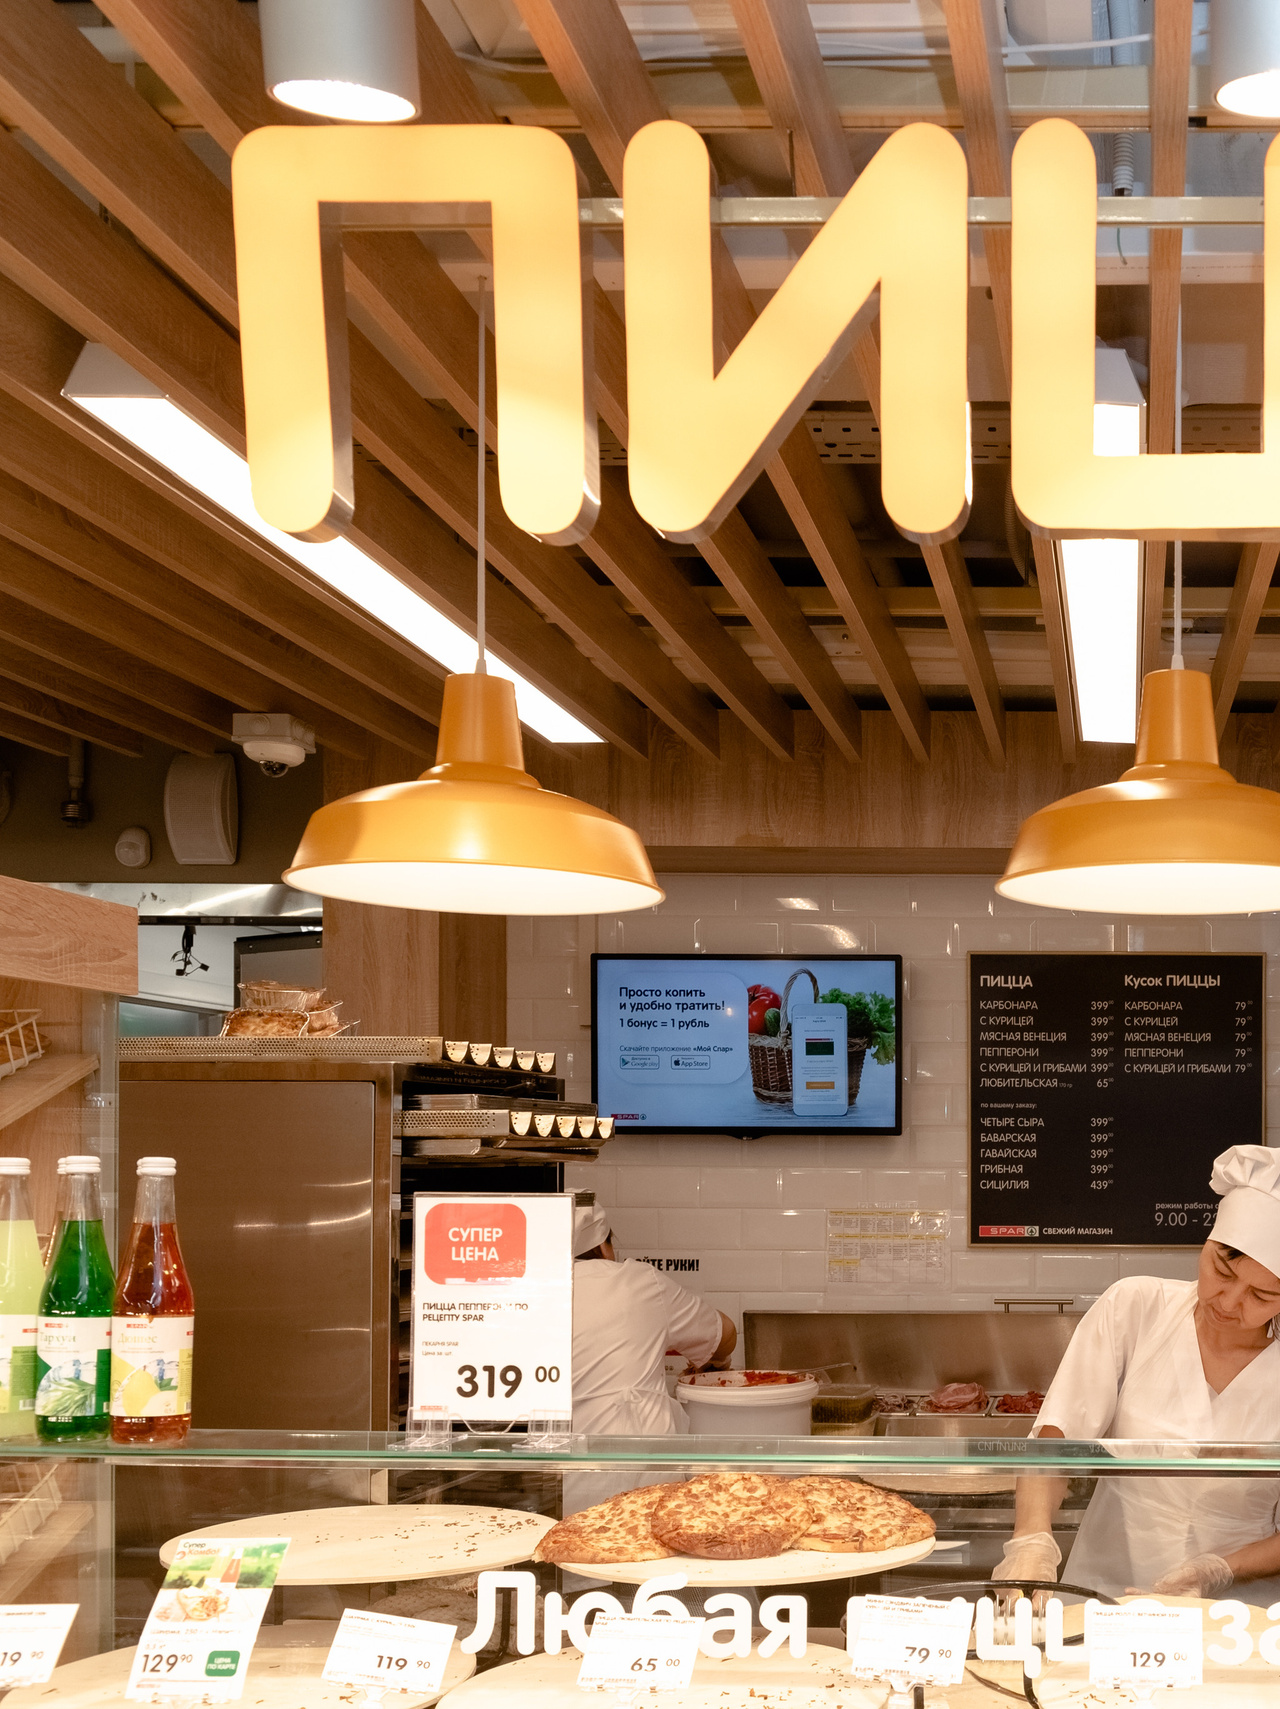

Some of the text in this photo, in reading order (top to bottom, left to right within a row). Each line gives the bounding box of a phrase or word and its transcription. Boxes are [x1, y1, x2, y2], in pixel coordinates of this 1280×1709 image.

[980, 975, 1033, 989] ПИЦЦА
[1125, 975, 1220, 989] Кусок ПИЦЦЫ
[619, 987, 705, 999] Просто копить
[619, 1001, 725, 1012] и удобно тратить!
[980, 1001, 1038, 1009] КАРБОНАРА
[1125, 1001, 1182, 1010] КАРБОНАРА
[620, 1018, 709, 1029] 1 бонус 1 рубль
[980, 1016, 1033, 1027] С КУРИЦЕЙ
[1125, 1017, 1178, 1027] С КУРИЦЕЙ
[980, 1032, 1066, 1043] МЯСНАЯ ВЕНЕЦИЯ
[1125, 1033, 1211, 1043] МЯСНАЯ ВЕНЕЦИЯ
[618, 1044, 650, 1053] Скачайте
[650, 1046, 692, 1054] приложение
[712, 1045, 734, 1054] Спар»
[980, 1047, 1038, 1056] ПЕППЕРОНИ
[1125, 1048, 1183, 1057] ПЕППЕРОНИ
[680, 1060, 694, 1068] App
[980, 1063, 1086, 1074] С КУРИЦЕЙ И ГРИБАМИ
[1125, 1063, 1231, 1074] С КУРИЦЕЙ И ГРИБАМИ
[980, 1078, 1057, 1087] ЛЮБИТЕЛЬСКАЯ
[988, 1102, 1015, 1110] вашему
[1015, 1102, 1038, 1110] заказу:
[981, 1118, 1044, 1126] ЧЕТЫРЕ СЫРА
[981, 1133, 1036, 1142] БАВАРСКАЯ
[981, 1148, 1036, 1158] ГАВАЙСКАЯ
[981, 1165, 1023, 1173] ГРИБНАЯ
[980, 1180, 1029, 1191] СИЦИЛИЯ
[1155, 1202, 1213, 1211] режим работы
[1155, 1212, 1187, 1226] 9.00
[449, 1227, 502, 1242] СУПЕР
[989, 1227, 1025, 1235] SPAR
[1043, 1226, 1114, 1236] СВЕЖИЙ МАГАЗИН
[451, 1247, 498, 1262] ЦЕНА
[666, 1259, 699, 1271] РУКИ!
[423, 1303, 456, 1312] ПИЦЦА
[423, 1313, 485, 1322] РЕЦЕПТУ SPAR
[118, 1333, 158, 1344] Дюшес
[456, 1365, 560, 1398] 319 00
[183, 1541, 207, 1550] Супер
[938, 1649, 952, 1658] 90
[377, 1655, 430, 1671] 119 90
[631, 1658, 681, 1671] 65 00
[1130, 1652, 1187, 1667] 129 00
